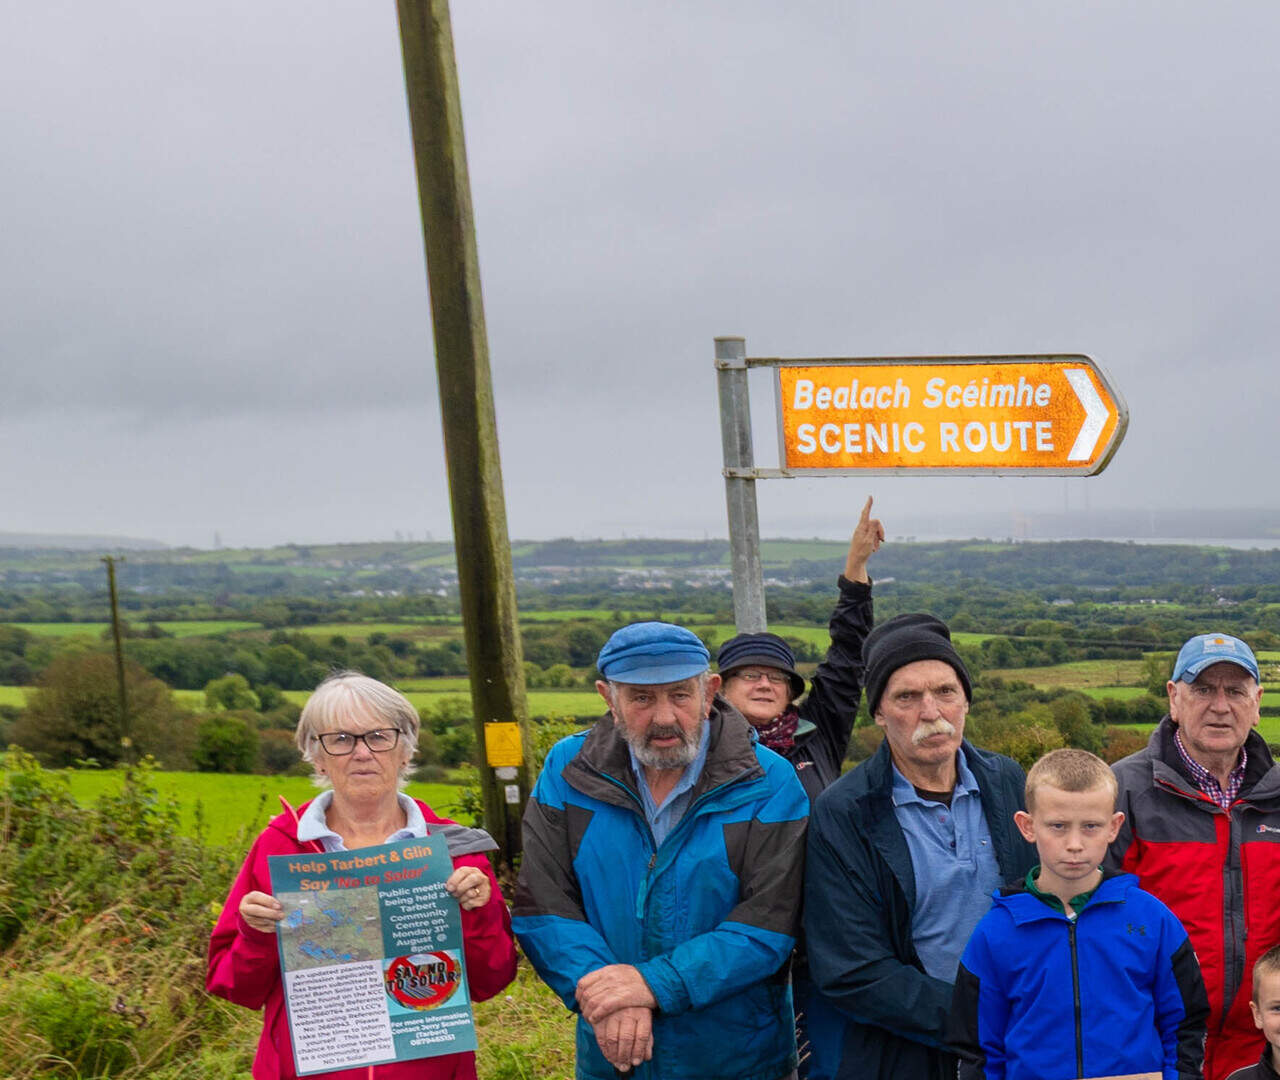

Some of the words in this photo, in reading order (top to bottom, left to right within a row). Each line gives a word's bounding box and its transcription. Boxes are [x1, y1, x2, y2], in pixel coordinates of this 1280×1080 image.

[793, 378, 910, 409] Bealach
[923, 376, 1051, 408] Scéimhe
[797, 422, 925, 454] SCENIC
[941, 421, 1053, 453] ROUTE
[289, 859, 326, 876] Help
[329, 853, 386, 870] Tarbert
[389, 850, 399, 861] &
[403, 846, 431, 858] Glin
[300, 877, 330, 894] Say
[364, 875, 379, 884] to
[379, 888, 409, 897] Public
[412, 882, 446, 892] meetin
[385, 896, 412, 906] being
[416, 892, 436, 900] held
[400, 902, 436, 911] Tarbert
[390, 908, 448, 922] Community
[396, 920, 428, 929] Centre
[393, 928, 432, 938] Monday
[396, 936, 431, 946] August
[394, 966, 419, 978] SAY
[428, 962, 445, 973] NO
[387, 979, 403, 990] TO
[409, 971, 455, 987] SOLAR
